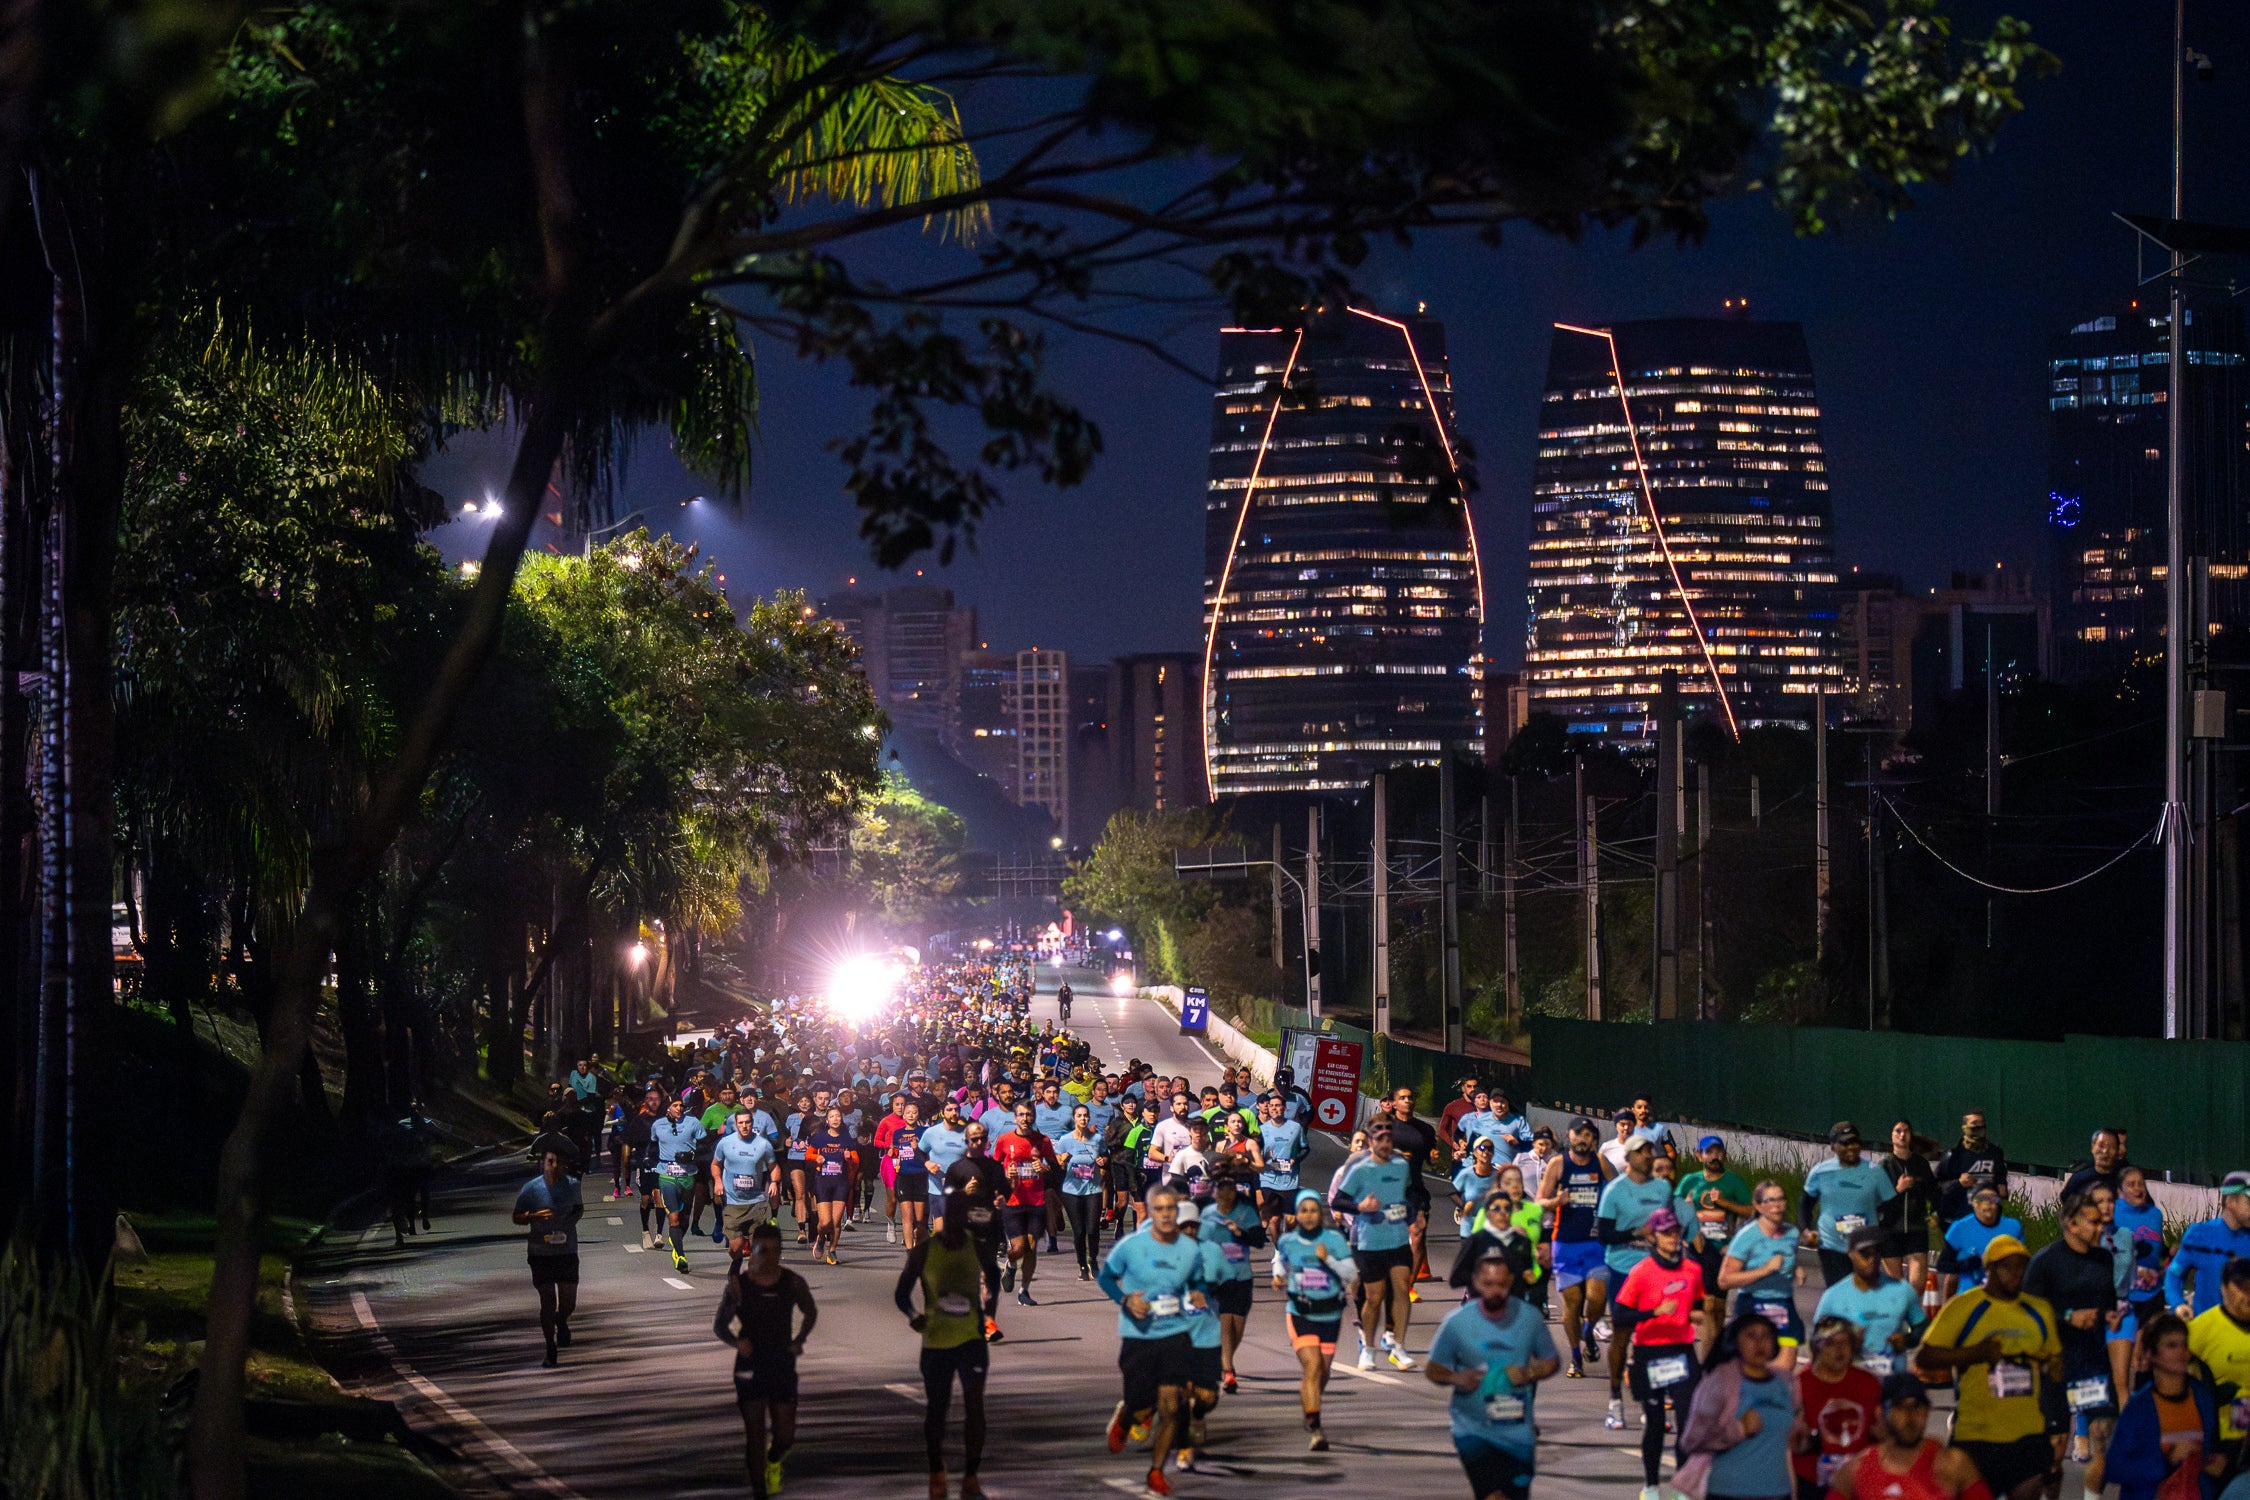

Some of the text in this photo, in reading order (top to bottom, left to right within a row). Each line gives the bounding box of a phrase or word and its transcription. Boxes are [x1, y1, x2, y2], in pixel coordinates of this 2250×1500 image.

[1186, 997, 1206, 1007] KM
[1190, 1008, 1201, 1023] 7
[1968, 1160, 1994, 1173] AR
